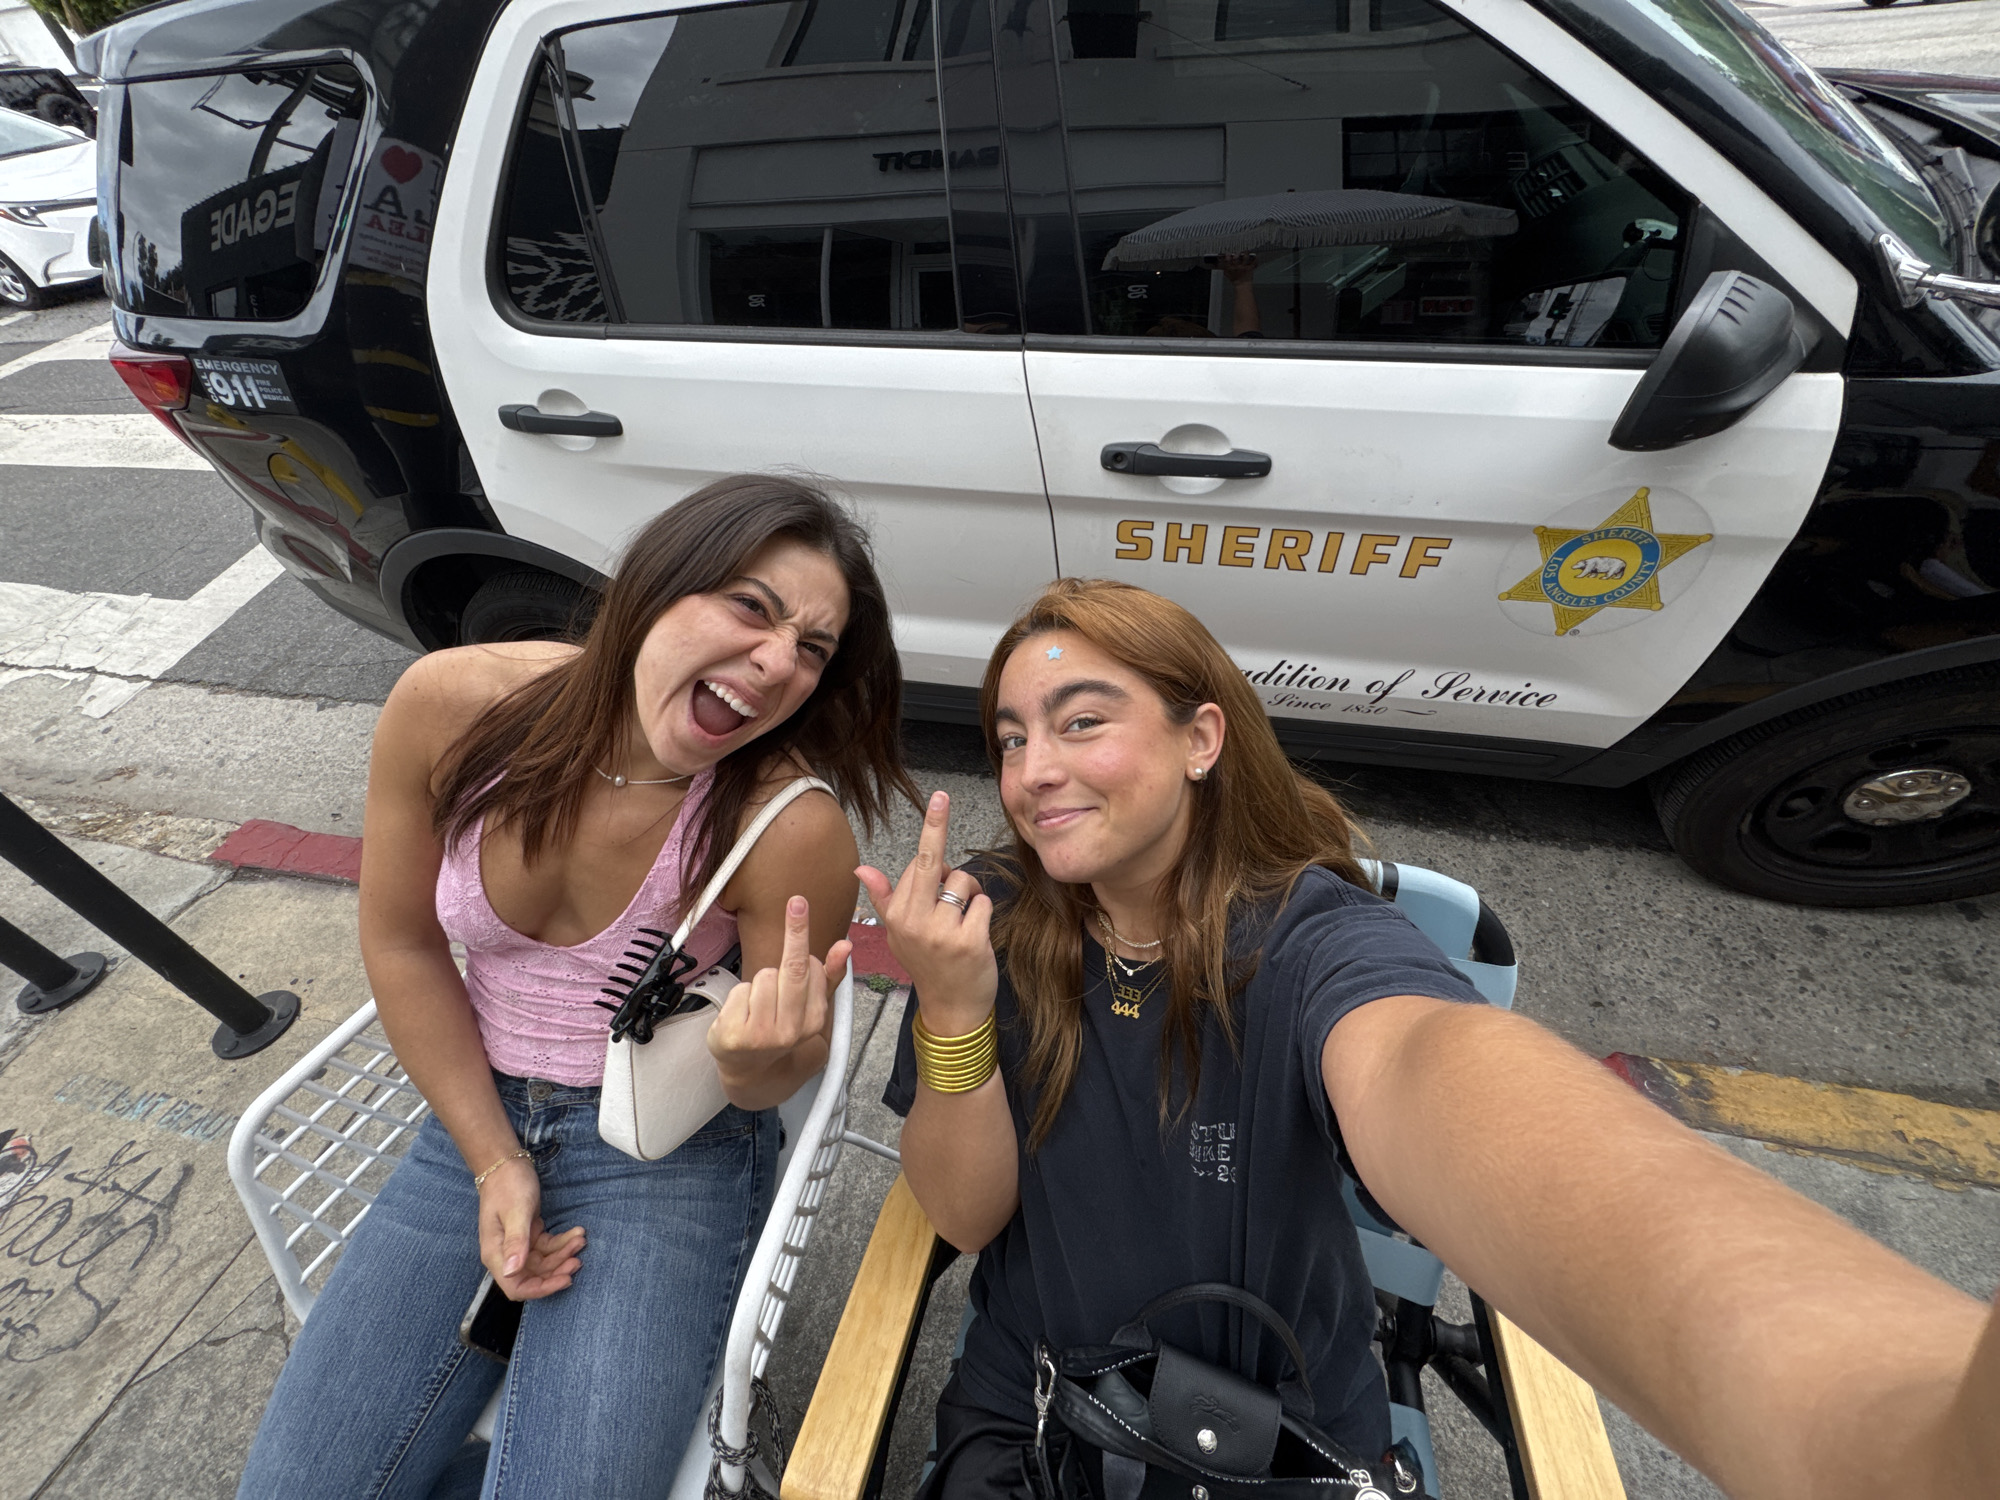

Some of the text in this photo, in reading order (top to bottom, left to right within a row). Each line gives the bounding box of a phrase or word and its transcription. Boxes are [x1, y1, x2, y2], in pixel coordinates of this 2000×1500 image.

[193, 358, 278, 375] EMERGENCY
[201, 371, 219, 403] CALL
[259, 387, 283, 395] POLICE
[262, 394, 292, 402] MEDICAL
[1581, 528, 1653, 545] SHERIFF
[1115, 519, 1453, 579] SHERIFF
[1544, 556, 1655, 606] LOS ANGELES COUNTY
[1365, 668, 1416, 706] of
[1422, 671, 1558, 708] Service
[1267, 692, 1389, 716] Since 1850
[1111, 1000, 1140, 1019] 444
